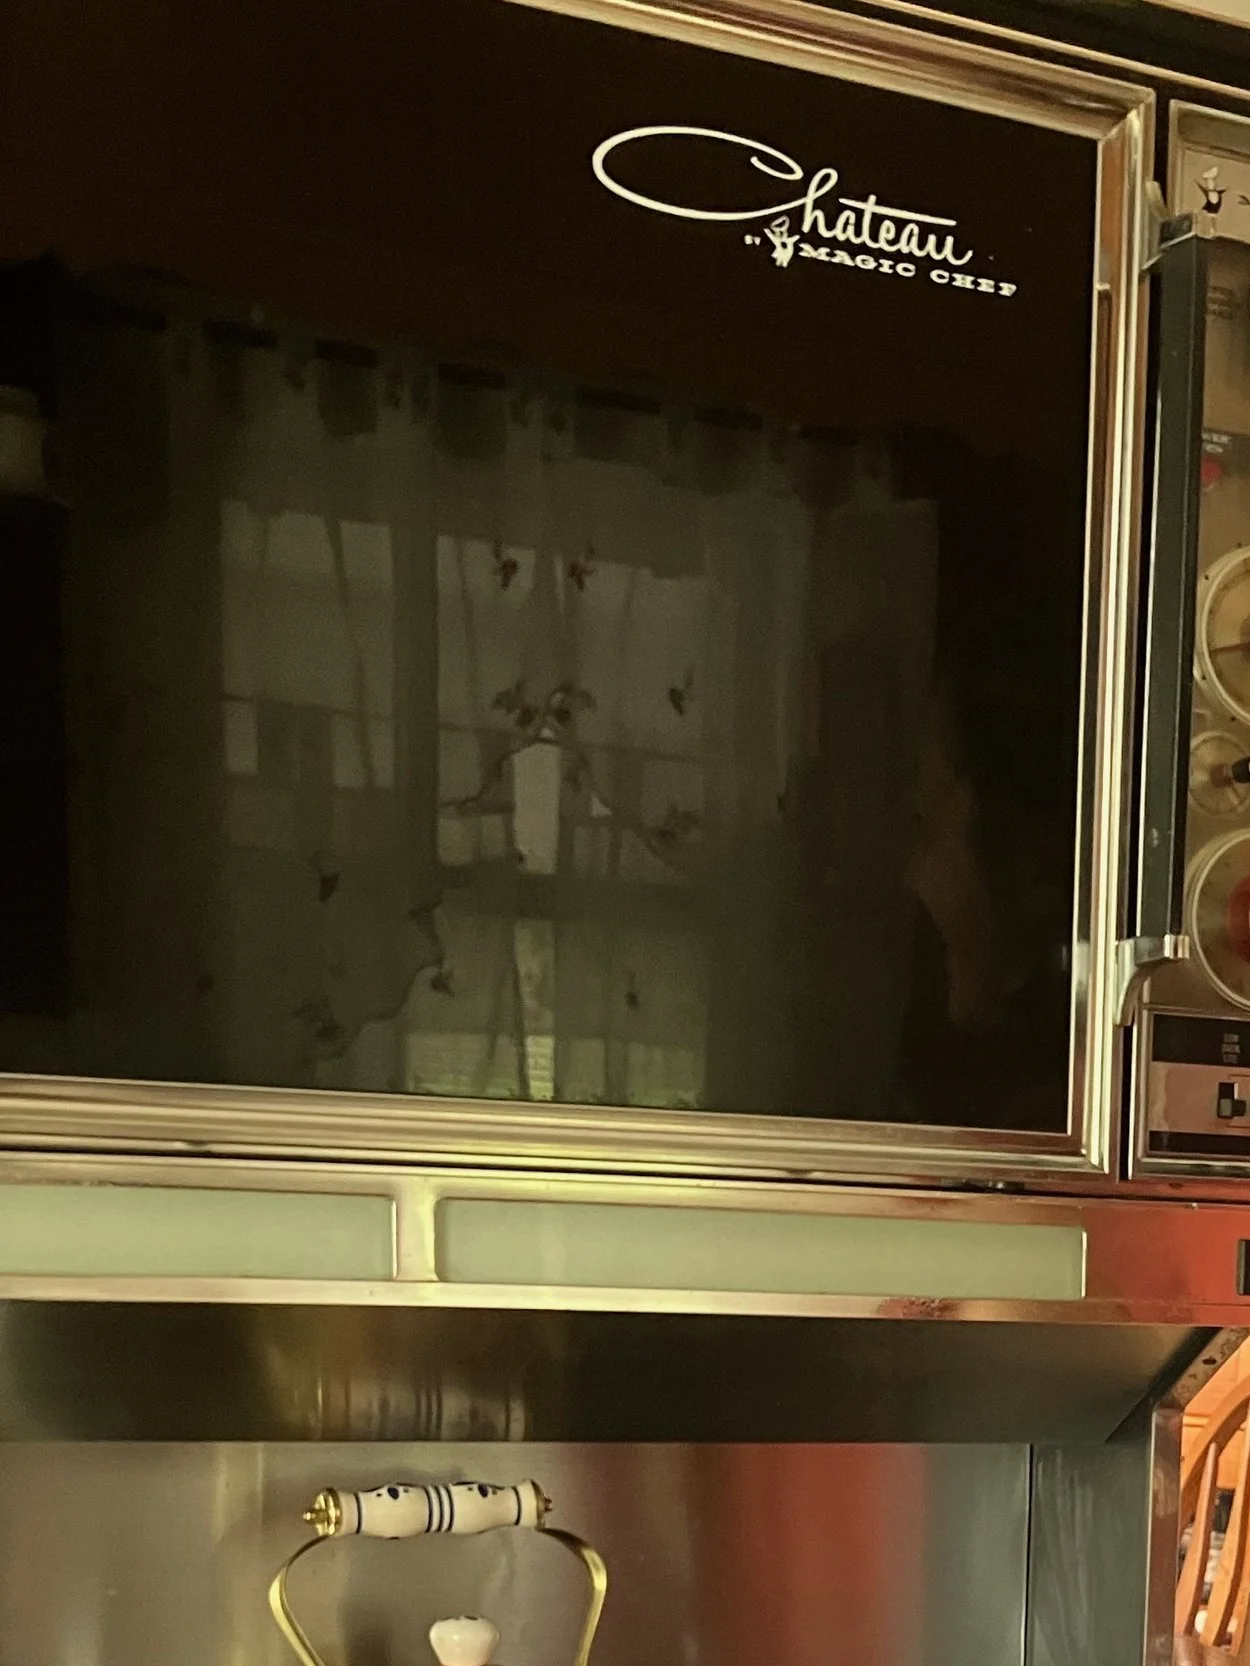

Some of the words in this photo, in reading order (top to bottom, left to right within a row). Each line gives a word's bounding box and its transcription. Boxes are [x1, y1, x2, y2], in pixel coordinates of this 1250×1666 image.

[591, 125, 973, 265] Chateau
[798, 243, 916, 277] MAGIC
[930, 269, 1017, 296] CHEF
